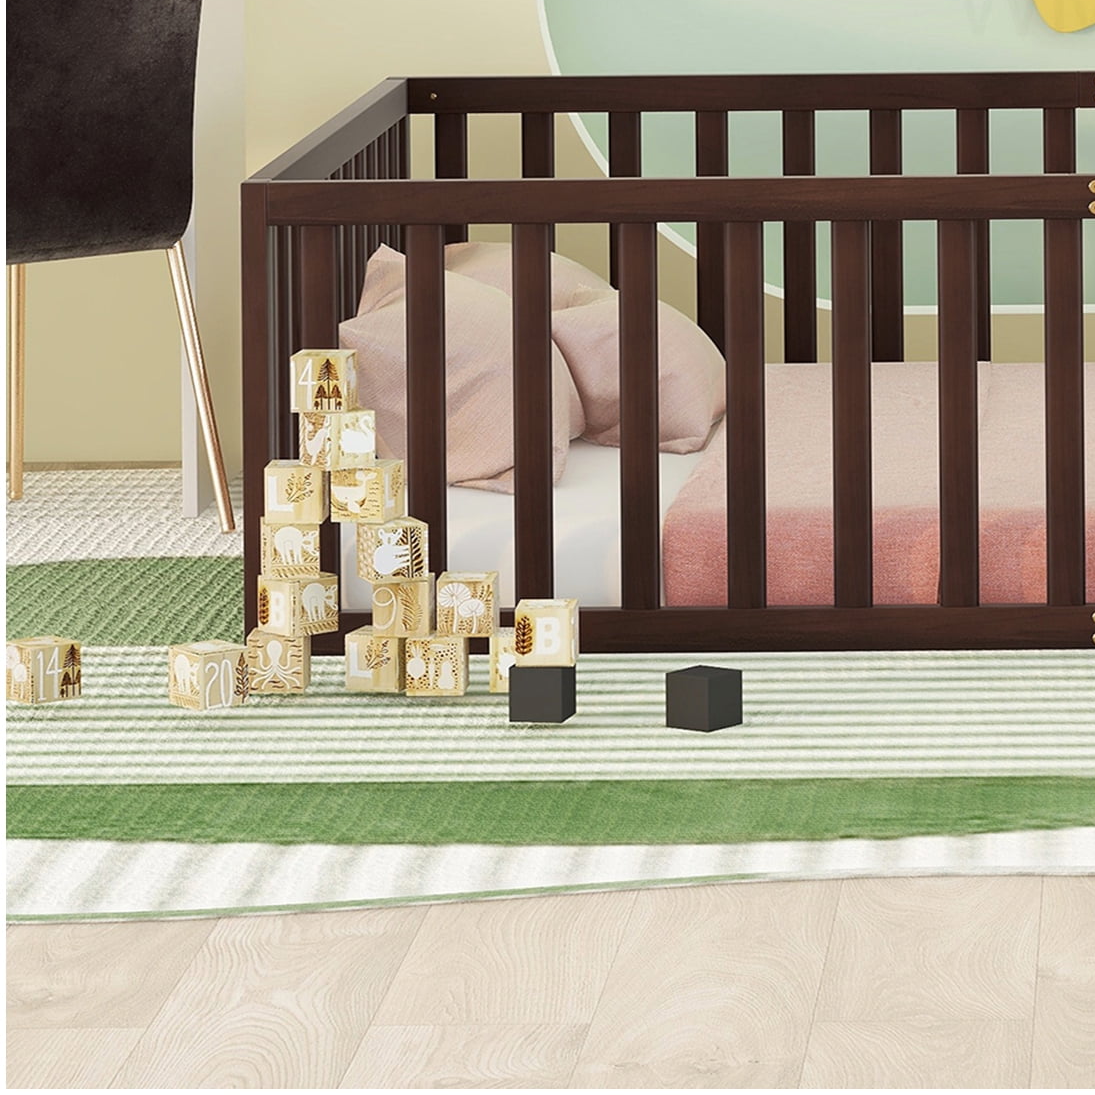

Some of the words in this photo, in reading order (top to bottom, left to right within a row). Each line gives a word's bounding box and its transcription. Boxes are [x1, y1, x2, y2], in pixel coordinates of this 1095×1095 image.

[267, 475, 295, 512] L
[269, 590, 286, 628] B
[372, 587, 397, 630] 9
[535, 616, 560, 656] B
[37, 646, 62, 702] 14
[350, 641, 373, 678] L
[204, 658, 234, 710] 20
